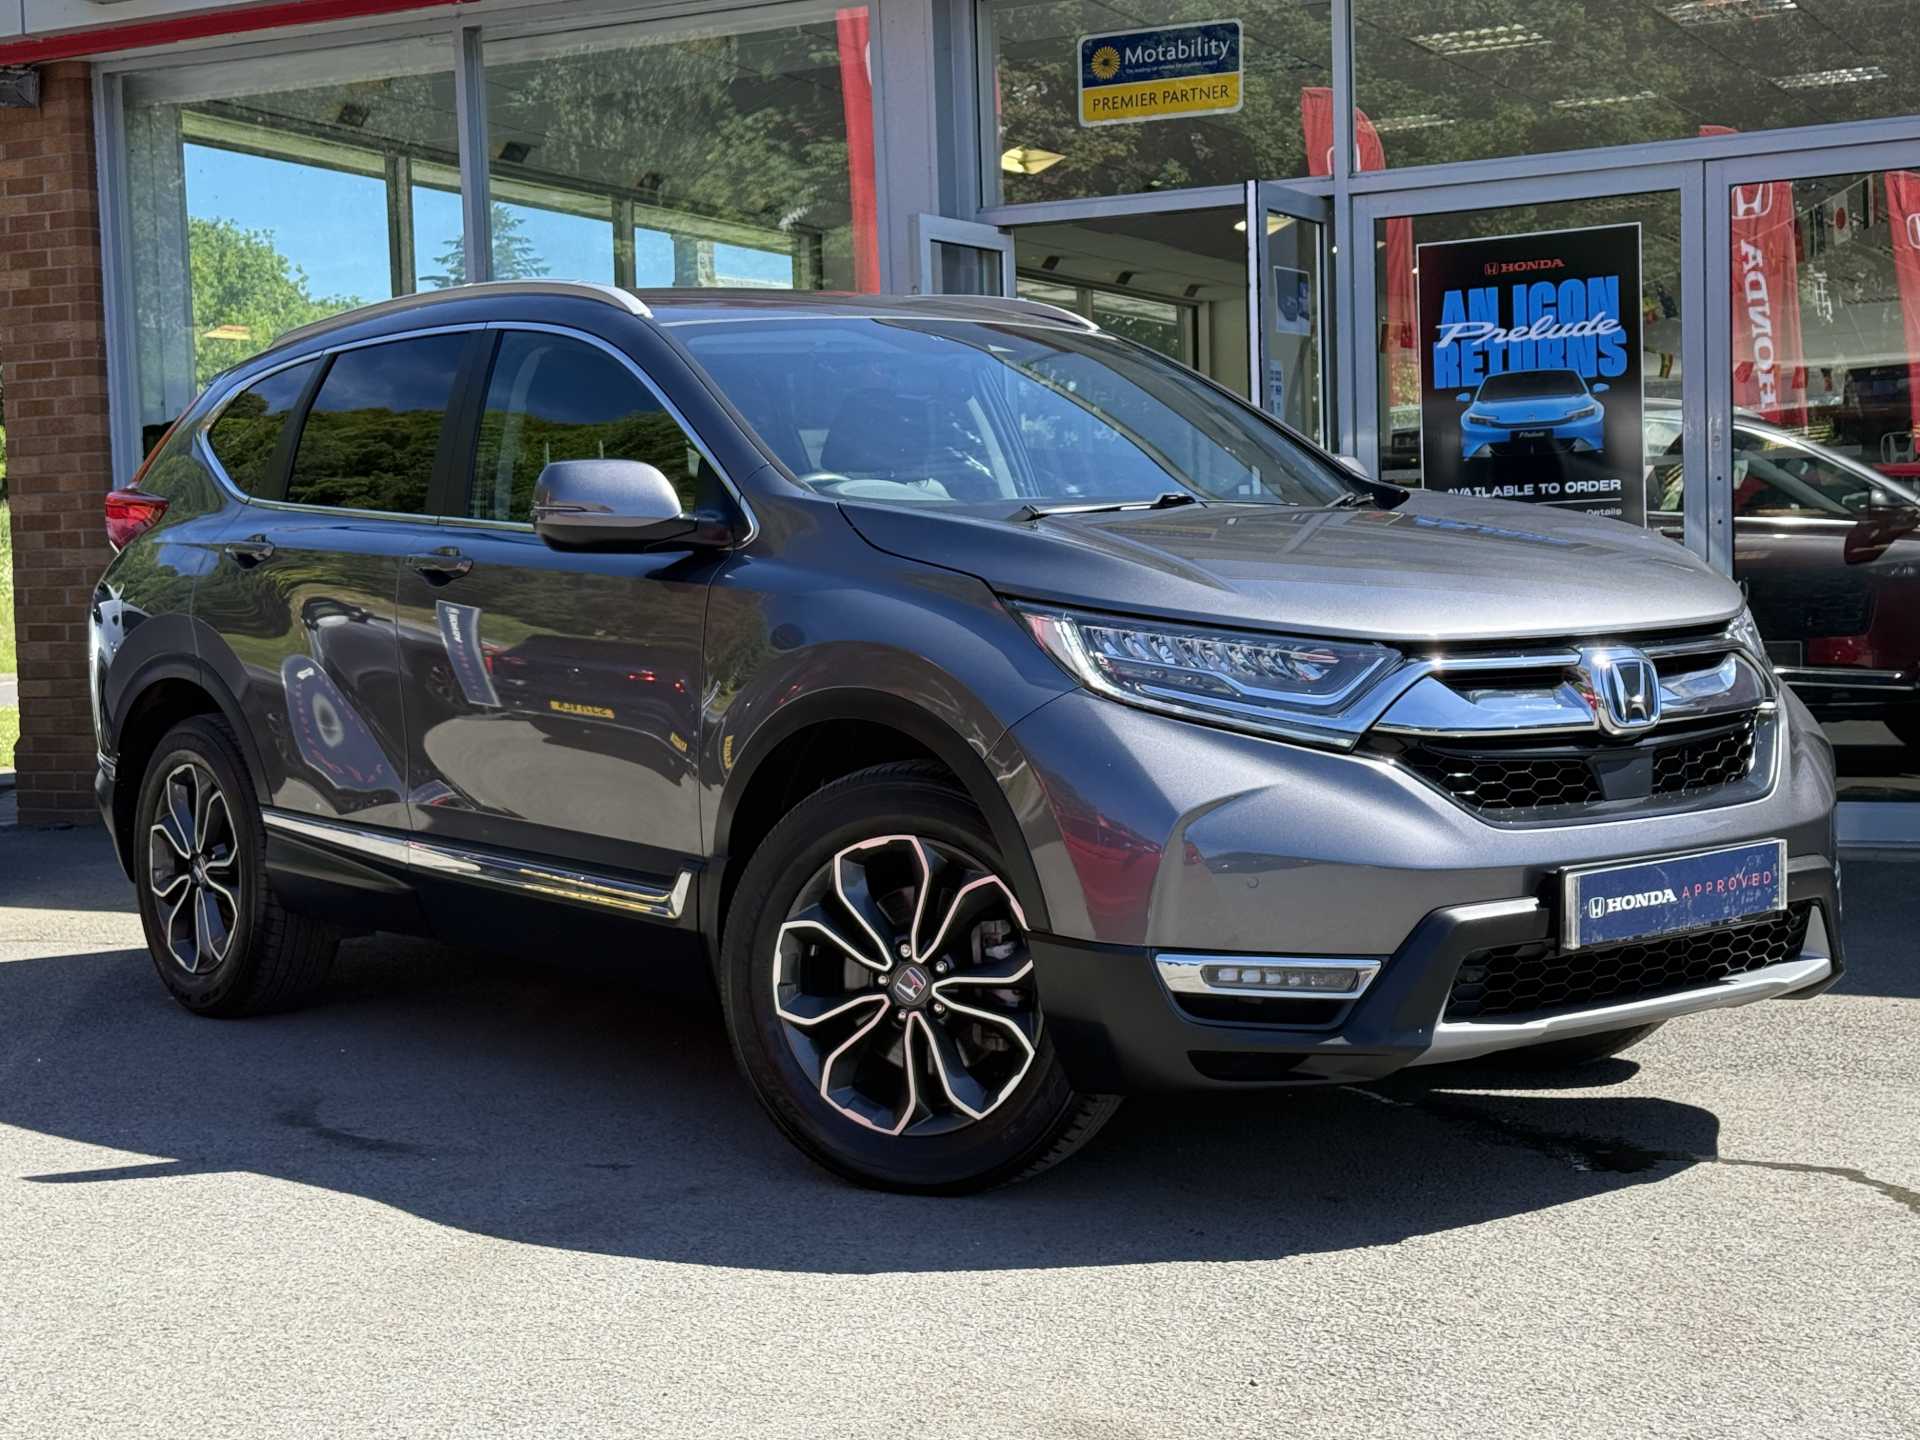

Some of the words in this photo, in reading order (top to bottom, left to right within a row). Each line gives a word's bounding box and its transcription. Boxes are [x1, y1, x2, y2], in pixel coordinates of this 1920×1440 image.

[1124, 37, 1231, 65] Motability
[1092, 92, 1158, 113] PREMIER
[1162, 84, 1231, 105] PARTNER
[1501, 258, 1565, 273] HONDA
[1440, 286, 1499, 339] AN
[1512, 275, 1620, 326] ICON
[1435, 311, 1623, 349] Prelude
[1432, 329, 1628, 390] RETURNS
[1539, 482, 1561, 495] TO
[1565, 479, 1622, 493] ORDER
[1606, 889, 1677, 914] HONDA
[1682, 871, 1772, 899] APPROVED
